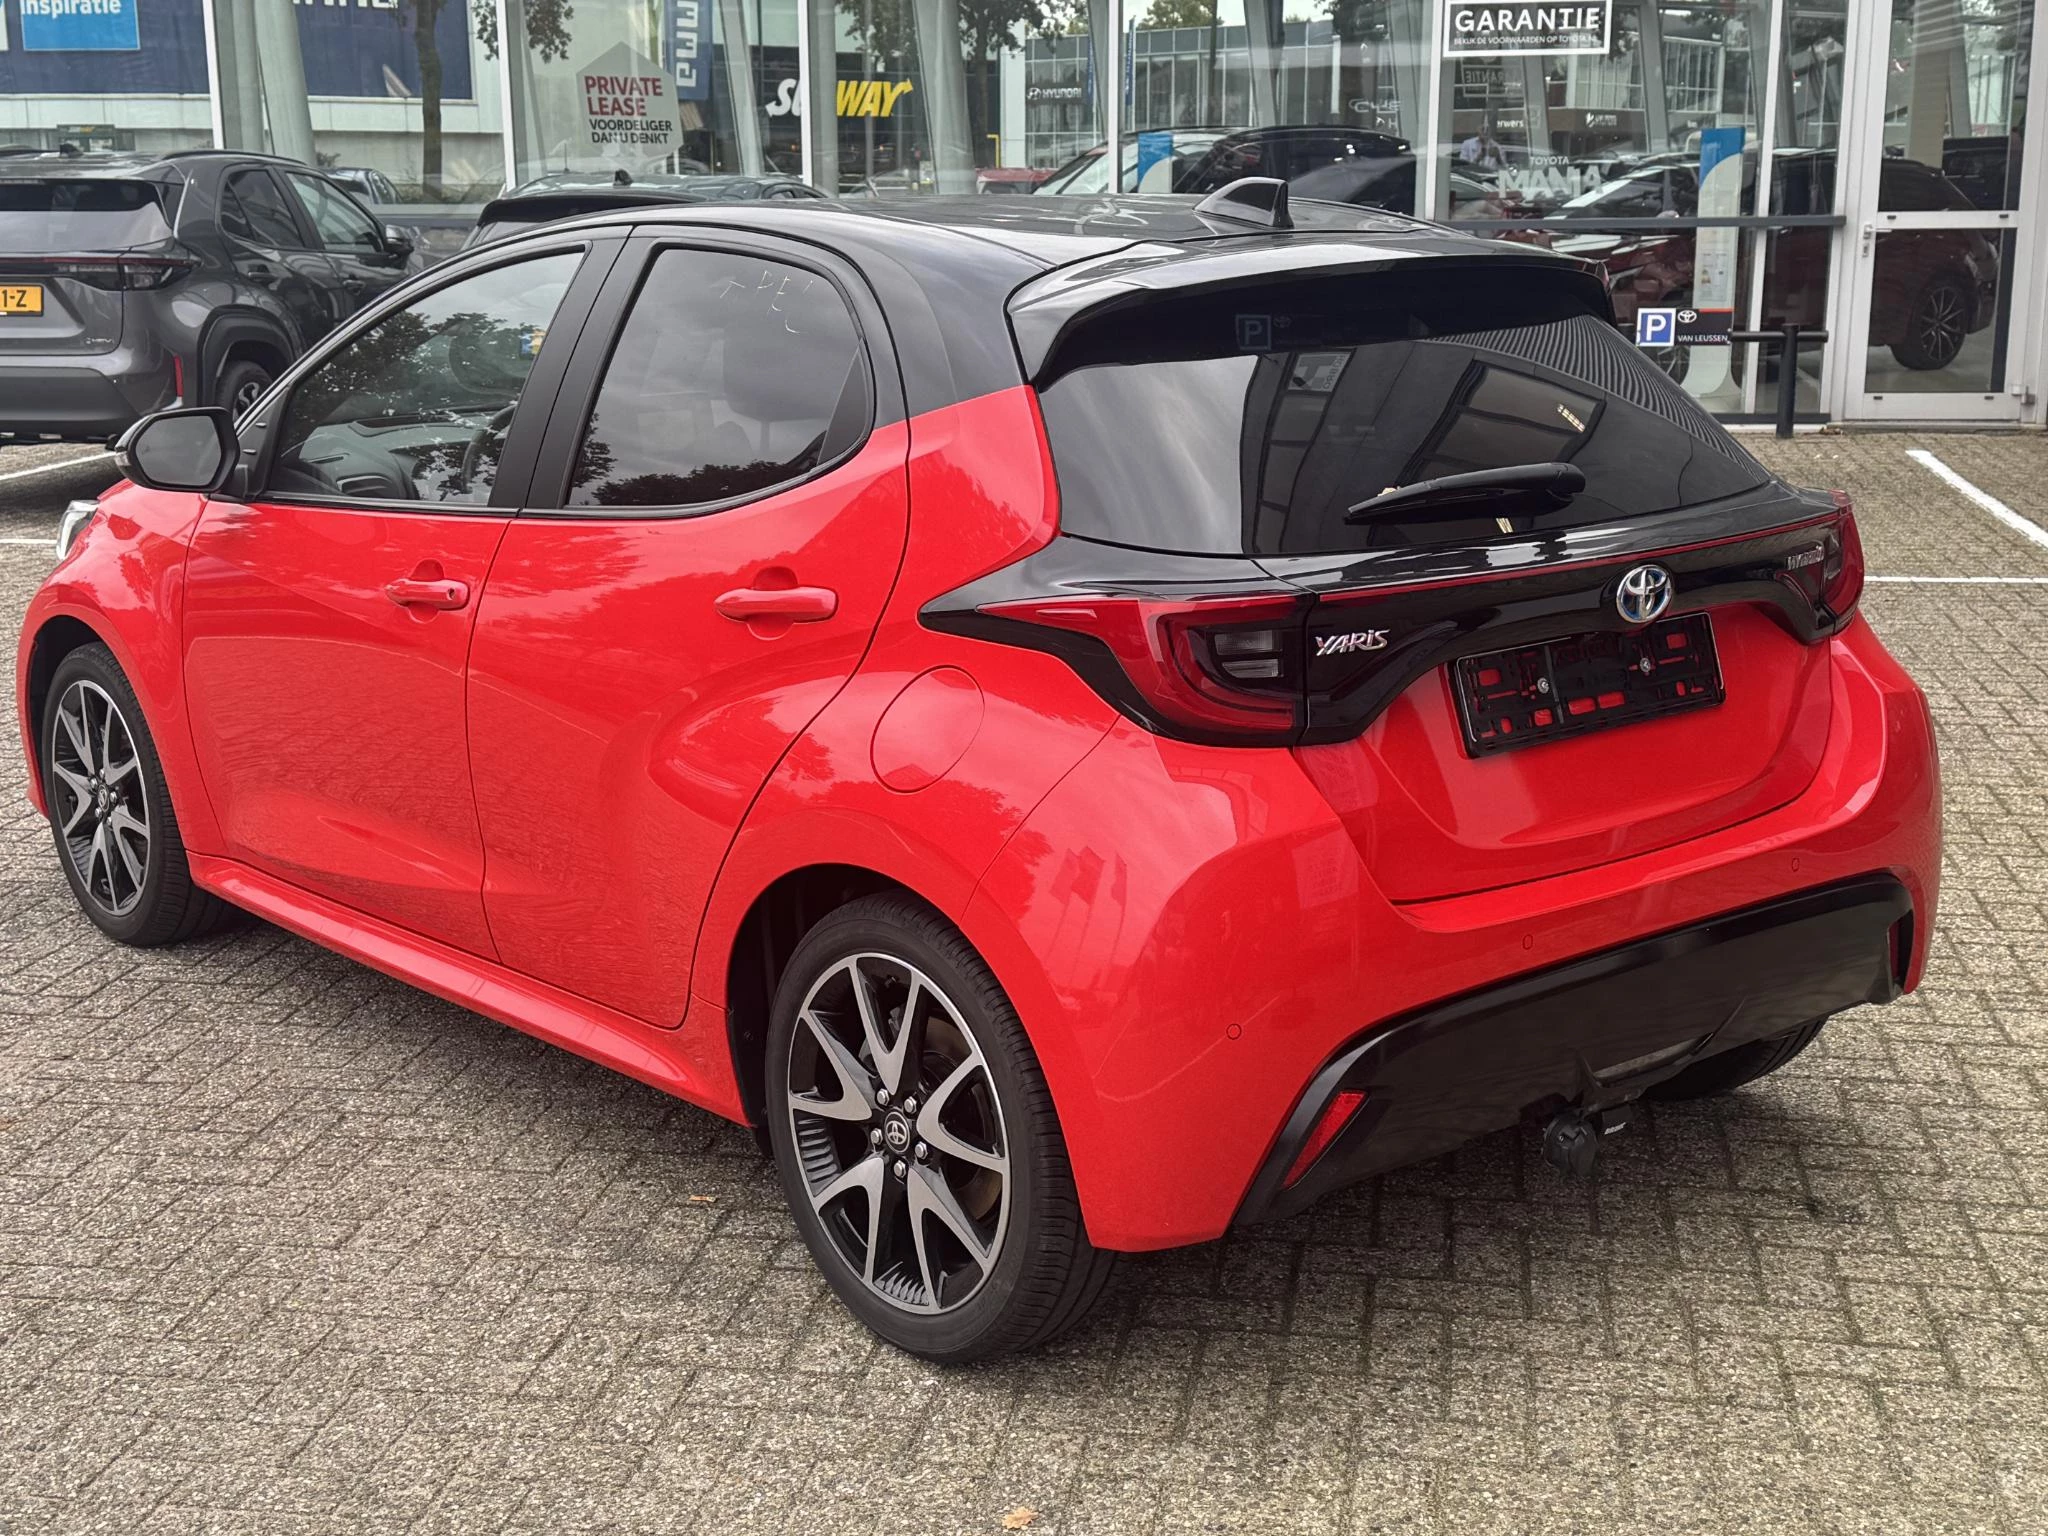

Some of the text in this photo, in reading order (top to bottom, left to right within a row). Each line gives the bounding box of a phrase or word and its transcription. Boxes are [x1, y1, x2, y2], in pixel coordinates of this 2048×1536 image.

[1455, 8, 1600, 31] GARANTIE
[1488, 35, 1545, 44] VOORWAARDEN
[584, 75, 663, 96] PRIVATE
[1042, 87, 1082, 99] HYUNDAI
[587, 97, 647, 116] LEASE
[589, 119, 672, 131] VOORDELIGER
[592, 132, 617, 143] DAN
[631, 132, 669, 144] DENKT
[1530, 156, 1570, 165] TOYOTA
[1646, 315, 1666, 341] P
[1315, 629, 1391, 656] YARIS
